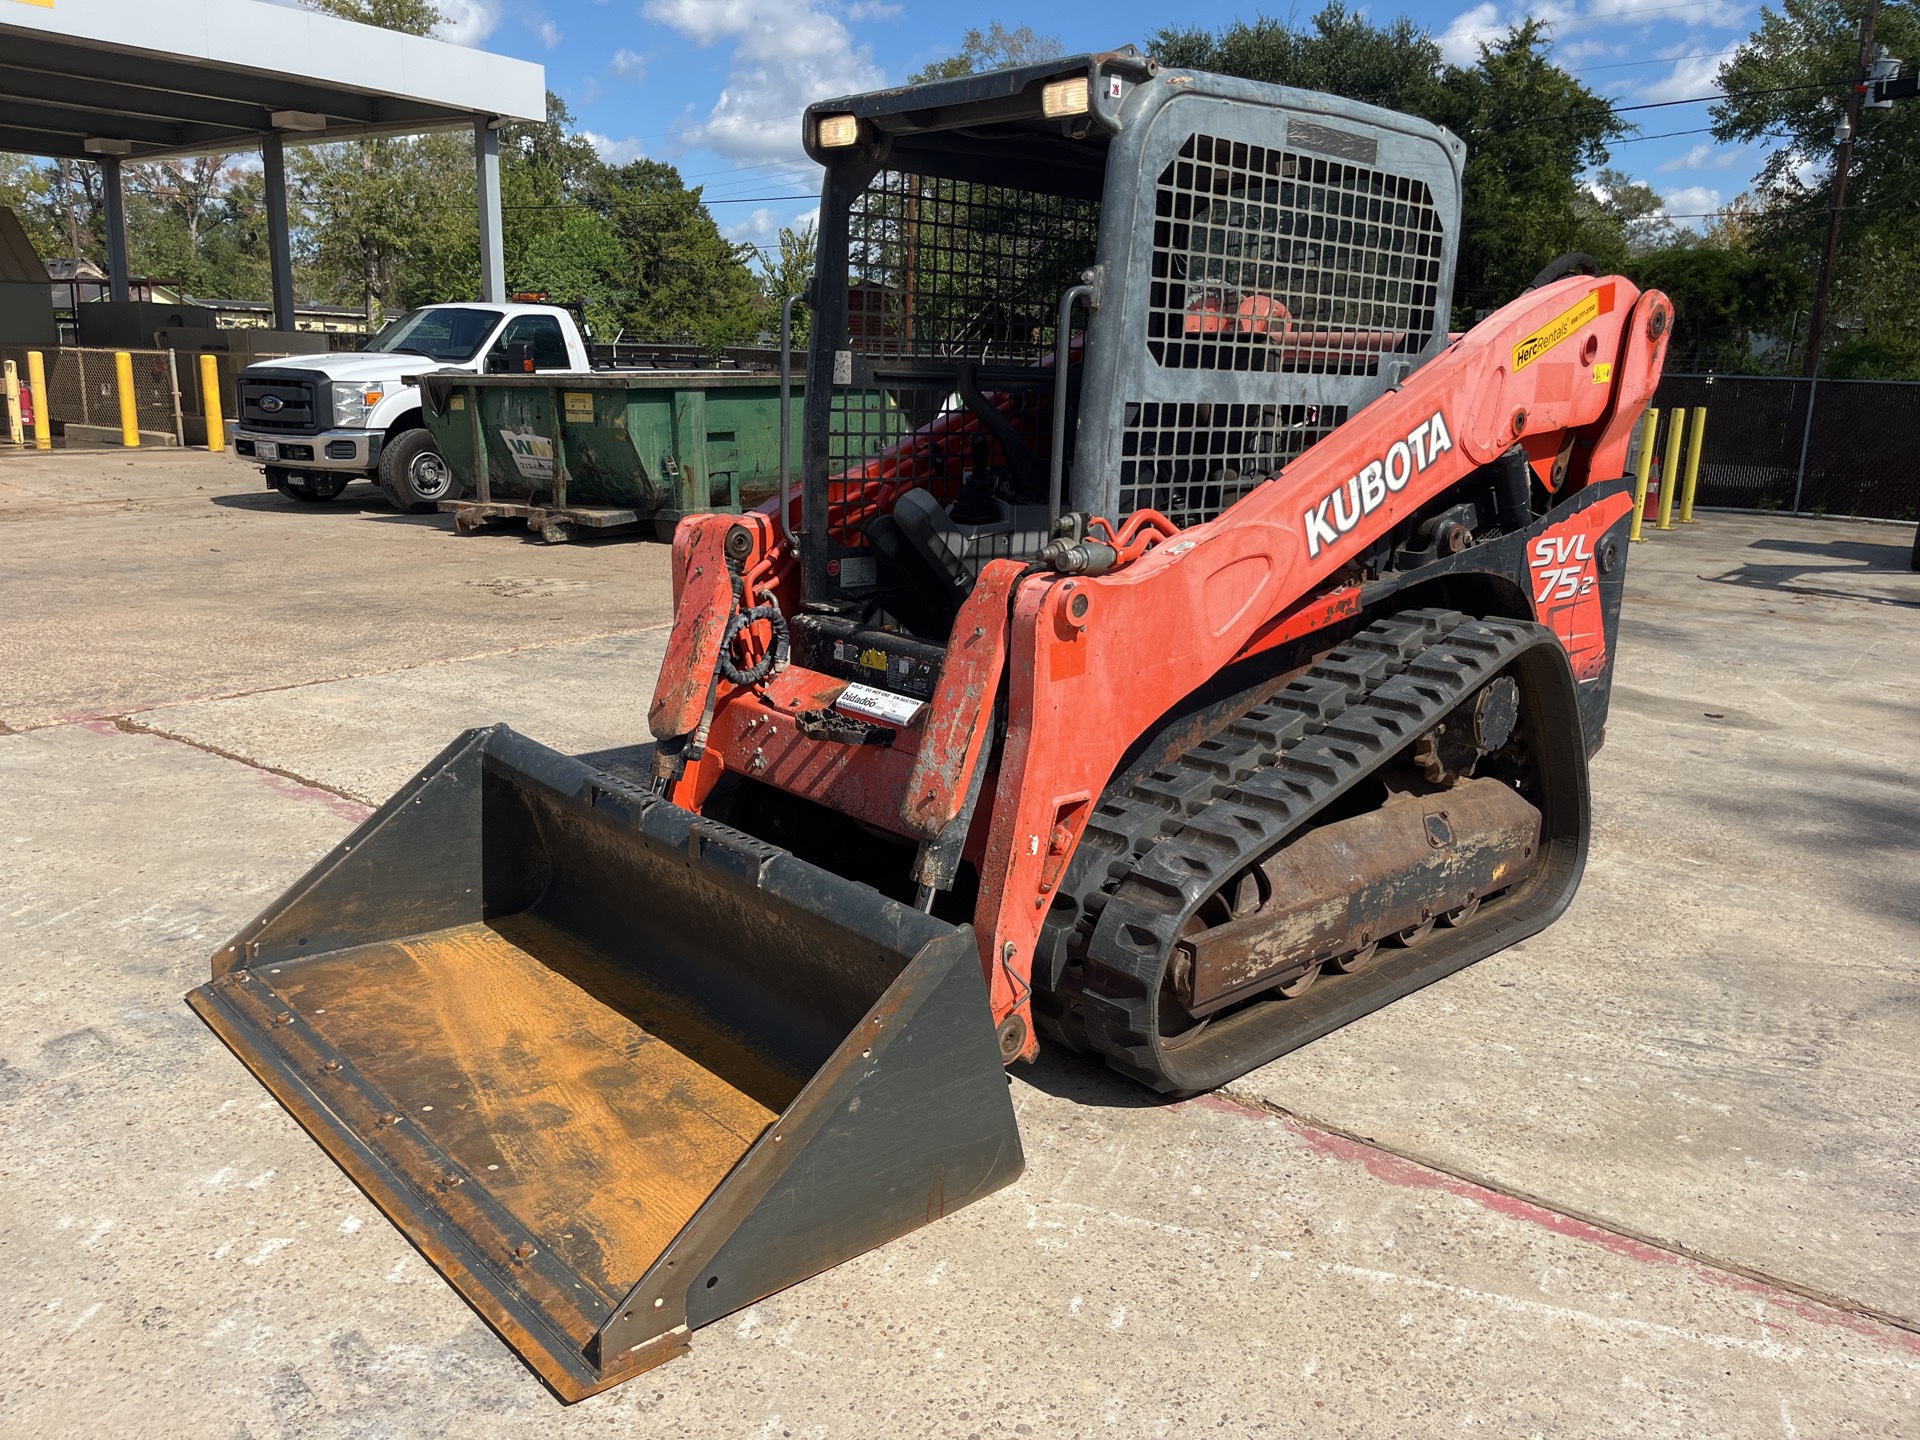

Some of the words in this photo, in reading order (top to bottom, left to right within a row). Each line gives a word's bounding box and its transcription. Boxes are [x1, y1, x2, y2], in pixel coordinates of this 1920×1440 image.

[1517, 322, 1567, 366] HercRentals
[1303, 410, 1453, 559] KUBOTA
[1530, 533, 1593, 568] SVL
[841, 692, 876, 708] bidadoo
[900, 697, 920, 705] AUCTION
